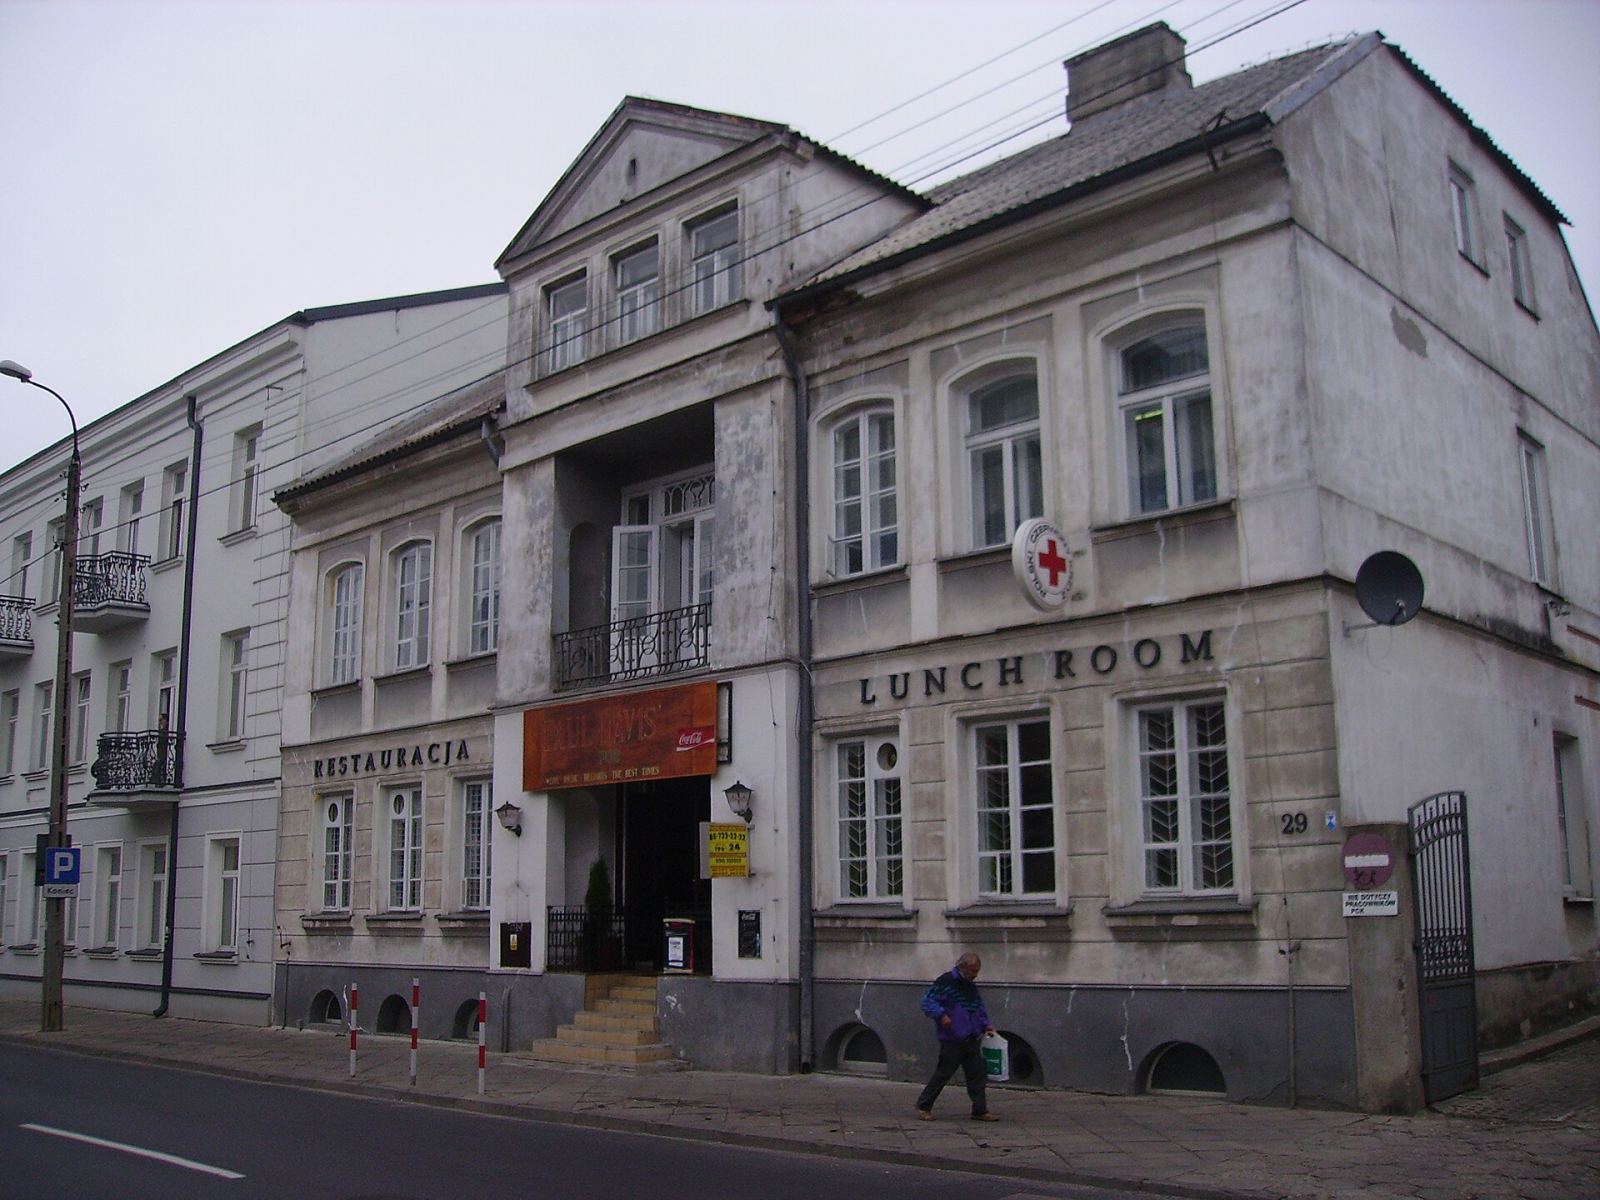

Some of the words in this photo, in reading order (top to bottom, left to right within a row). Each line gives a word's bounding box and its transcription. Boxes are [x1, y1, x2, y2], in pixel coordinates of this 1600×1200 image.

[859, 655, 1024, 705] LUNCH
[1053, 629, 1214, 680] ROOM
[314, 739, 470, 778] RESTAURACJA
[624, 768, 638, 778] BEST
[1281, 812, 1308, 835] 29
[54, 851, 74, 880] P
